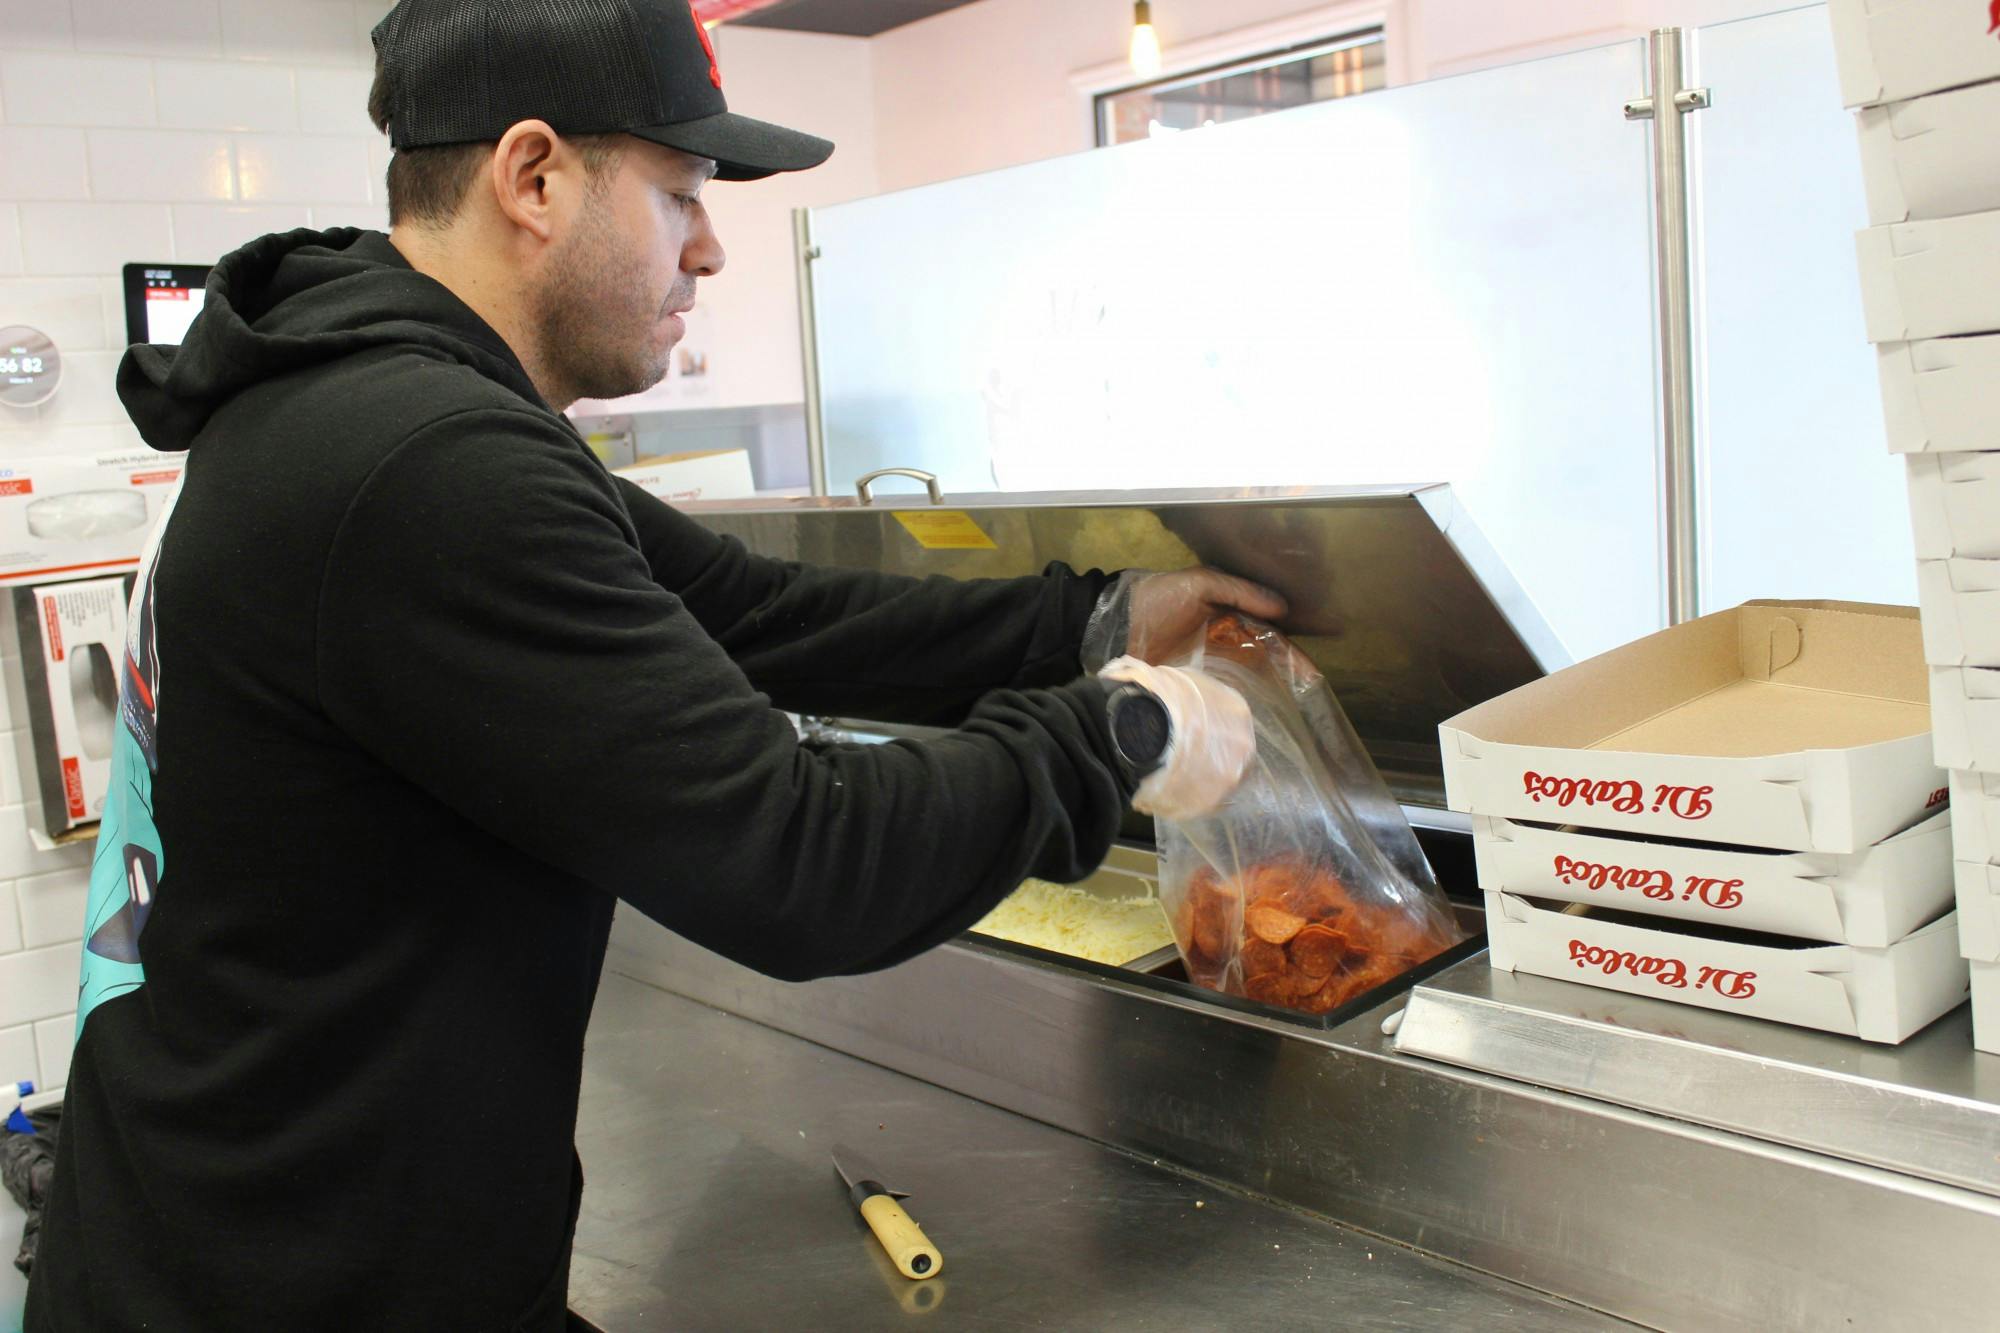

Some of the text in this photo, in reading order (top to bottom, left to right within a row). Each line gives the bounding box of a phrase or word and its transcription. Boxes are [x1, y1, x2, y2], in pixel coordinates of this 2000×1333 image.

[22, 357, 43, 373] 82
[68, 767, 83, 810] Classic
[1523, 770, 1713, 820] Di Carlo's
[1554, 854, 1744, 910] Di Carlo's
[1569, 939, 1757, 999] Di Carlo's
